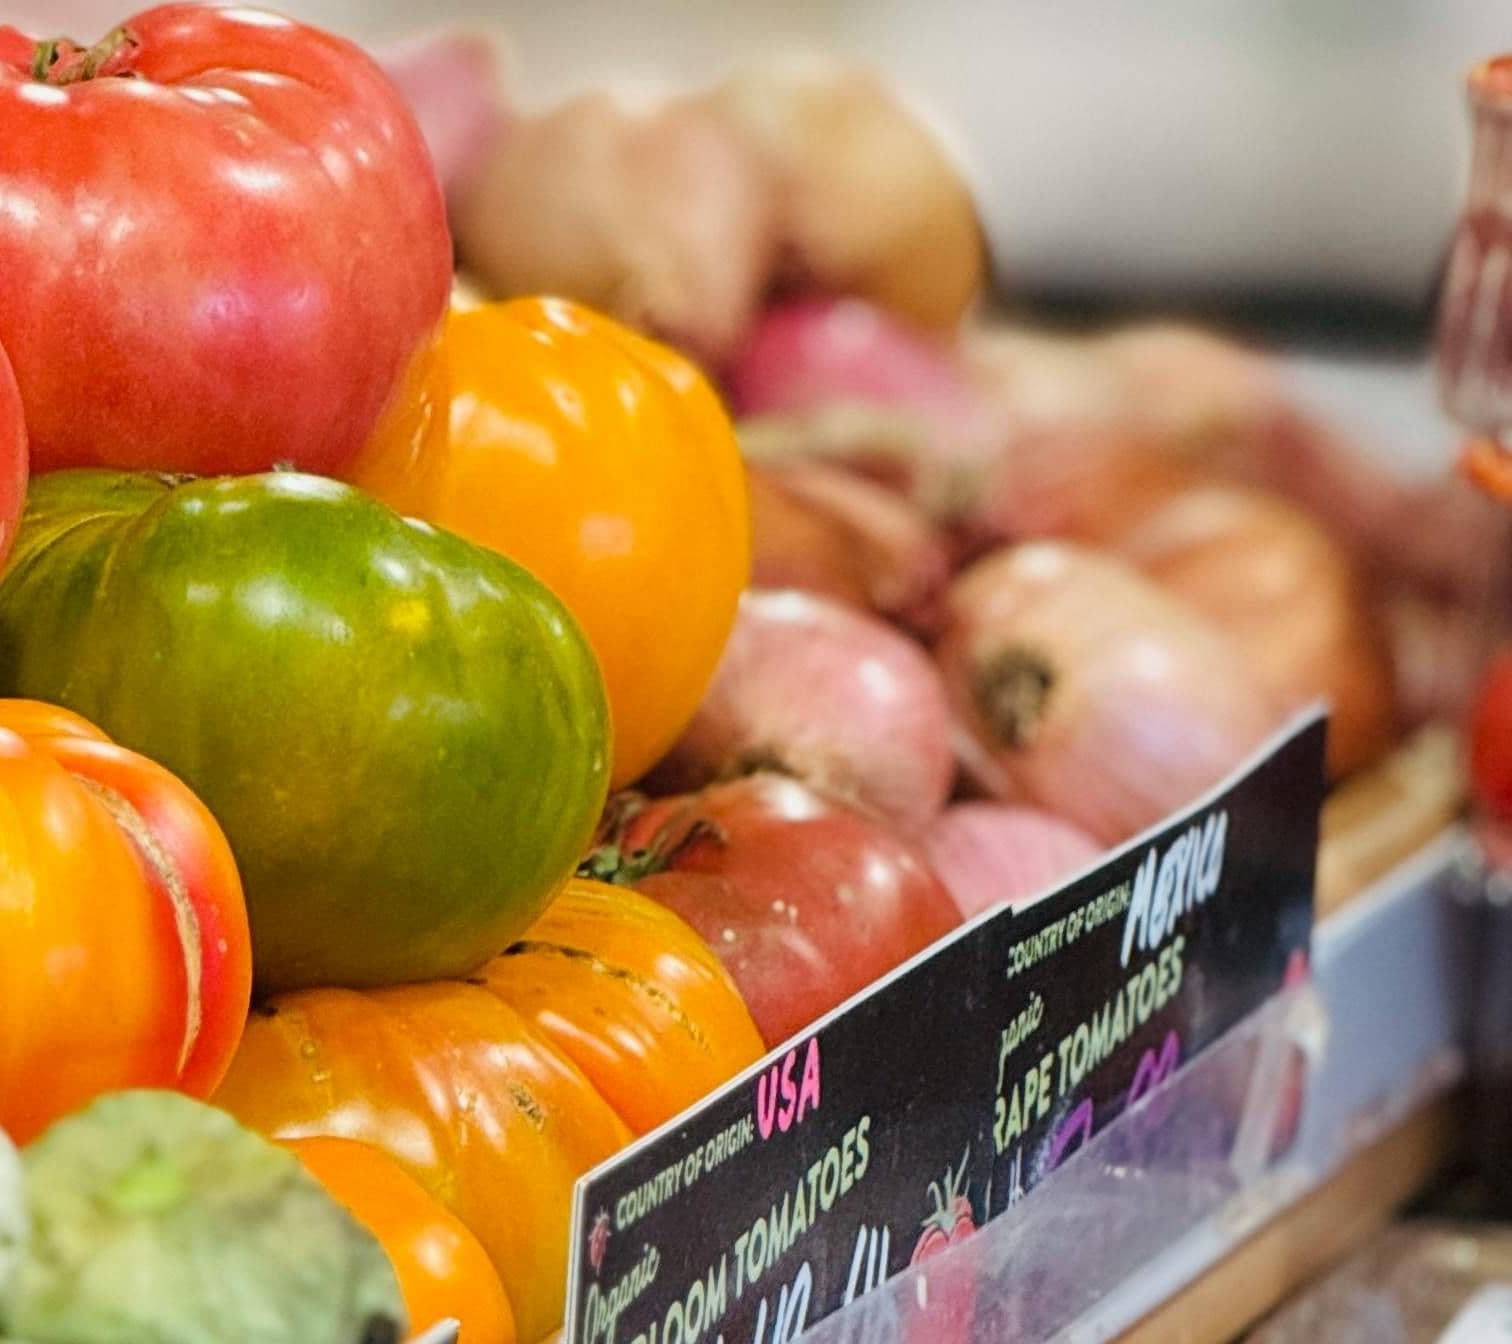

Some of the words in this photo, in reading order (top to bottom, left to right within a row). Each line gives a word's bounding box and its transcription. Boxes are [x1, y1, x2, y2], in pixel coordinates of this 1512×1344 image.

[1066, 905, 1085, 945] OF
[1058, 934, 1186, 1098] TOMATOES
[756, 1035, 821, 1140] USA
[616, 1159, 684, 1230] COUNTRY
[683, 1146, 704, 1186] OF
[704, 1113, 755, 1173] ORIGIN:
[734, 1115, 871, 1300] TOMATOES
